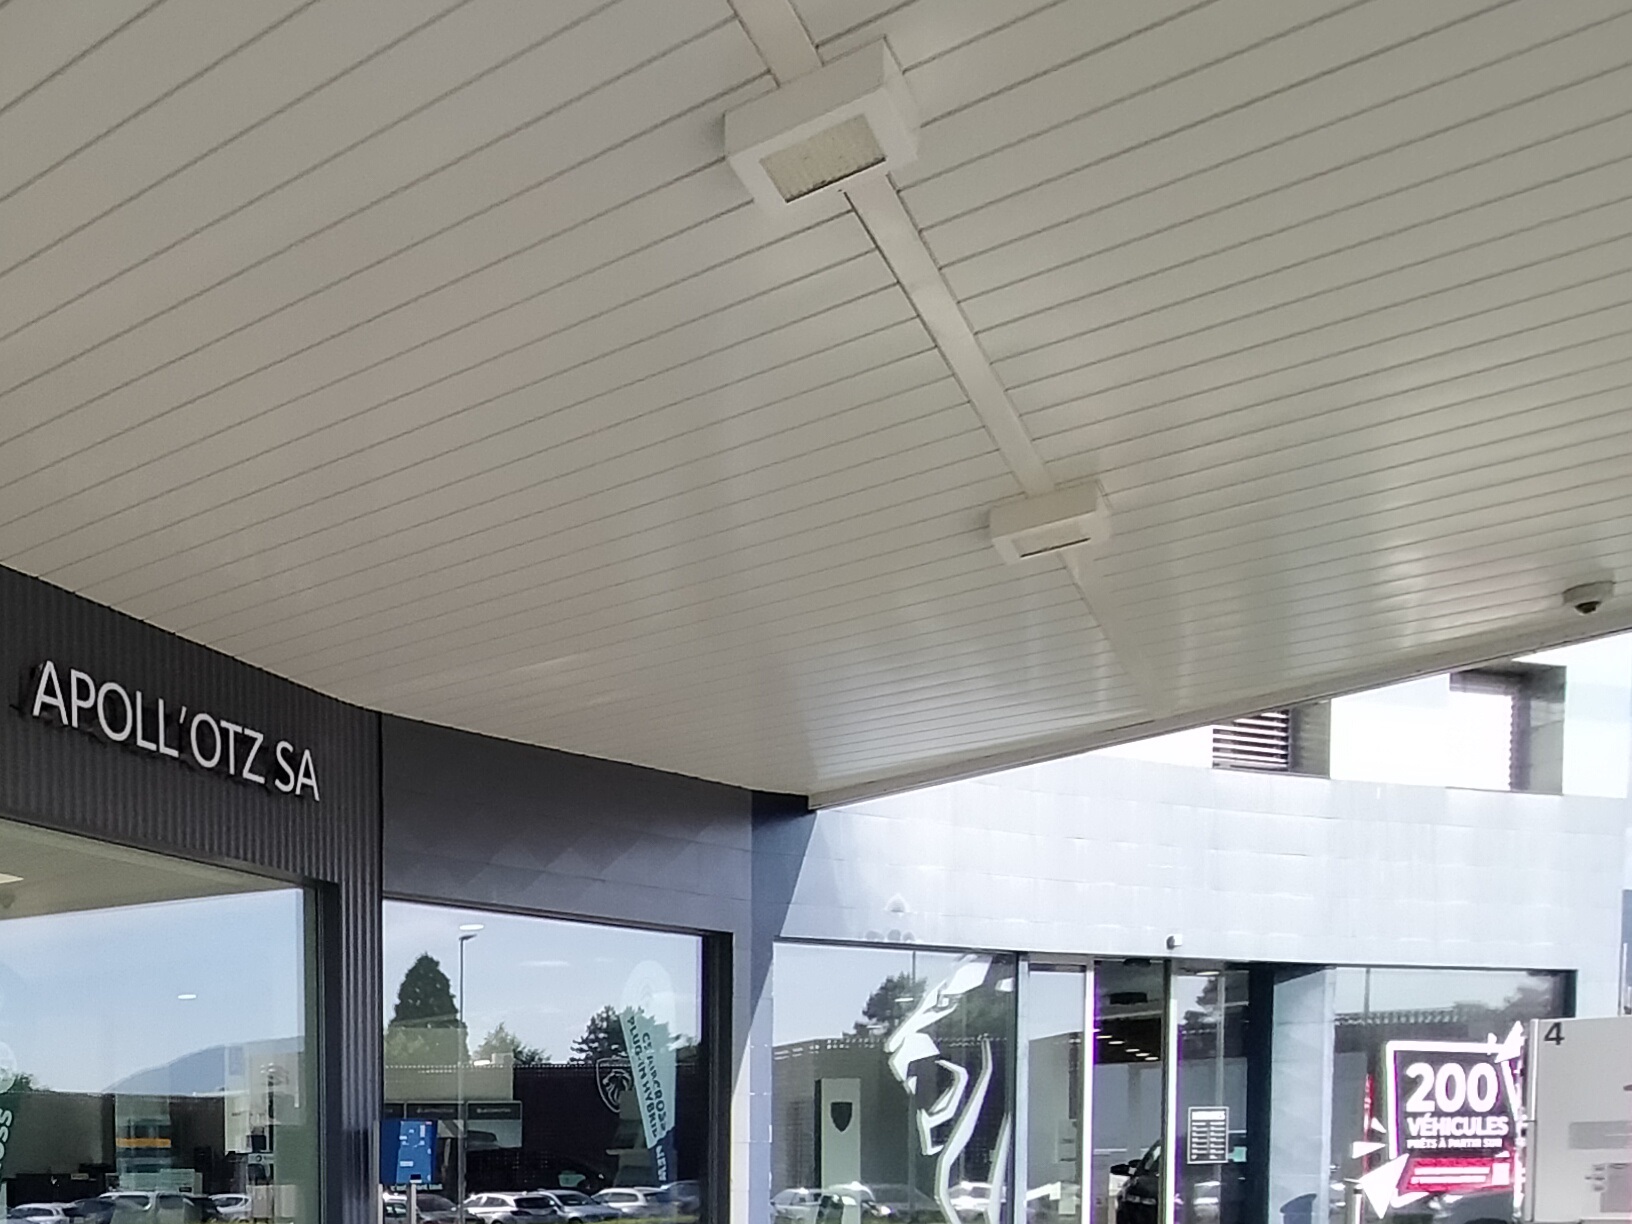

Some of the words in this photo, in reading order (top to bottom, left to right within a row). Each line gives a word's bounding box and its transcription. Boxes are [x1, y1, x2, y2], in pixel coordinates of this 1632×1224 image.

[32, 659, 266, 785] APOLL'OTZ
[274, 740, 320, 802] SA
[1543, 1022, 1566, 1046] 4
[1405, 1062, 1500, 1114] 200
[1406, 1113, 1511, 1137] VÉHICULES
